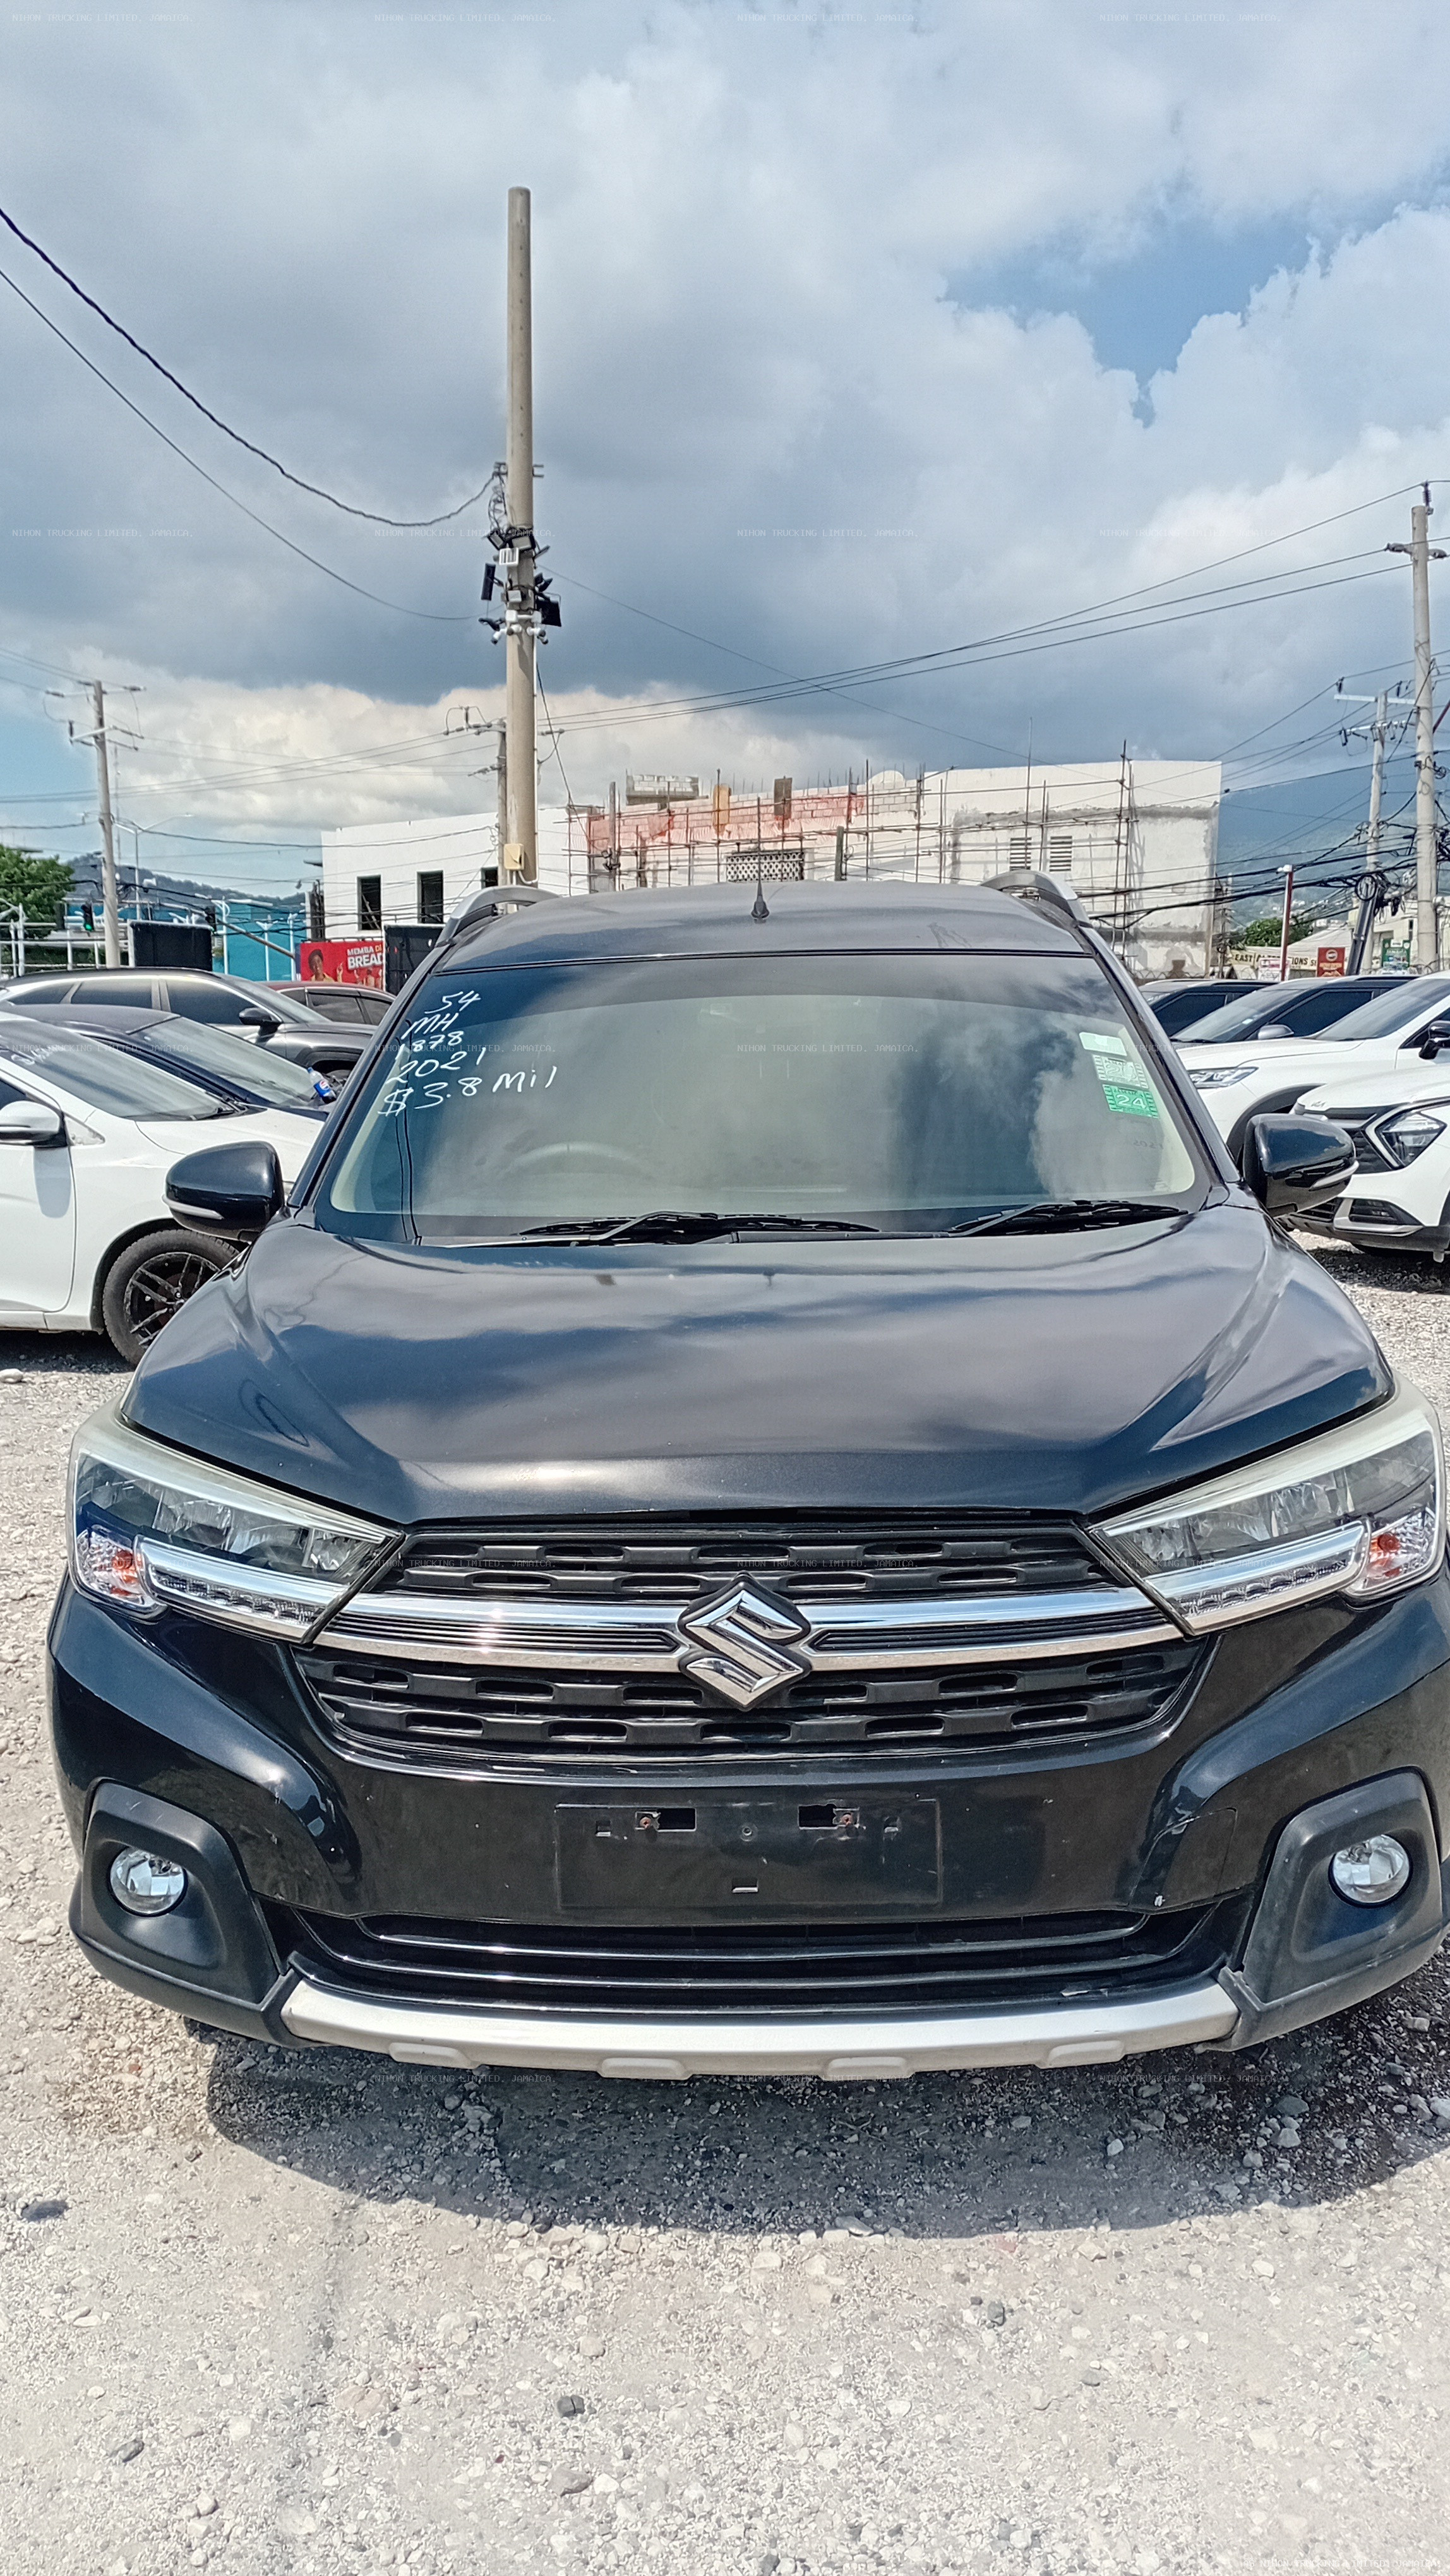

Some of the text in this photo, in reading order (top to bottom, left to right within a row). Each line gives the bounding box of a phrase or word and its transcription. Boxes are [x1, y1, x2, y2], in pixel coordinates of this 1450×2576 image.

[347, 946, 374, 956] MEMBA
[425, 990, 481, 1013] 54
[401, 1013, 458, 1039] MH
[395, 1030, 464, 1060] 1878
[385, 1047, 486, 1083] 2021
[1116, 1094, 1146, 1109] 24
